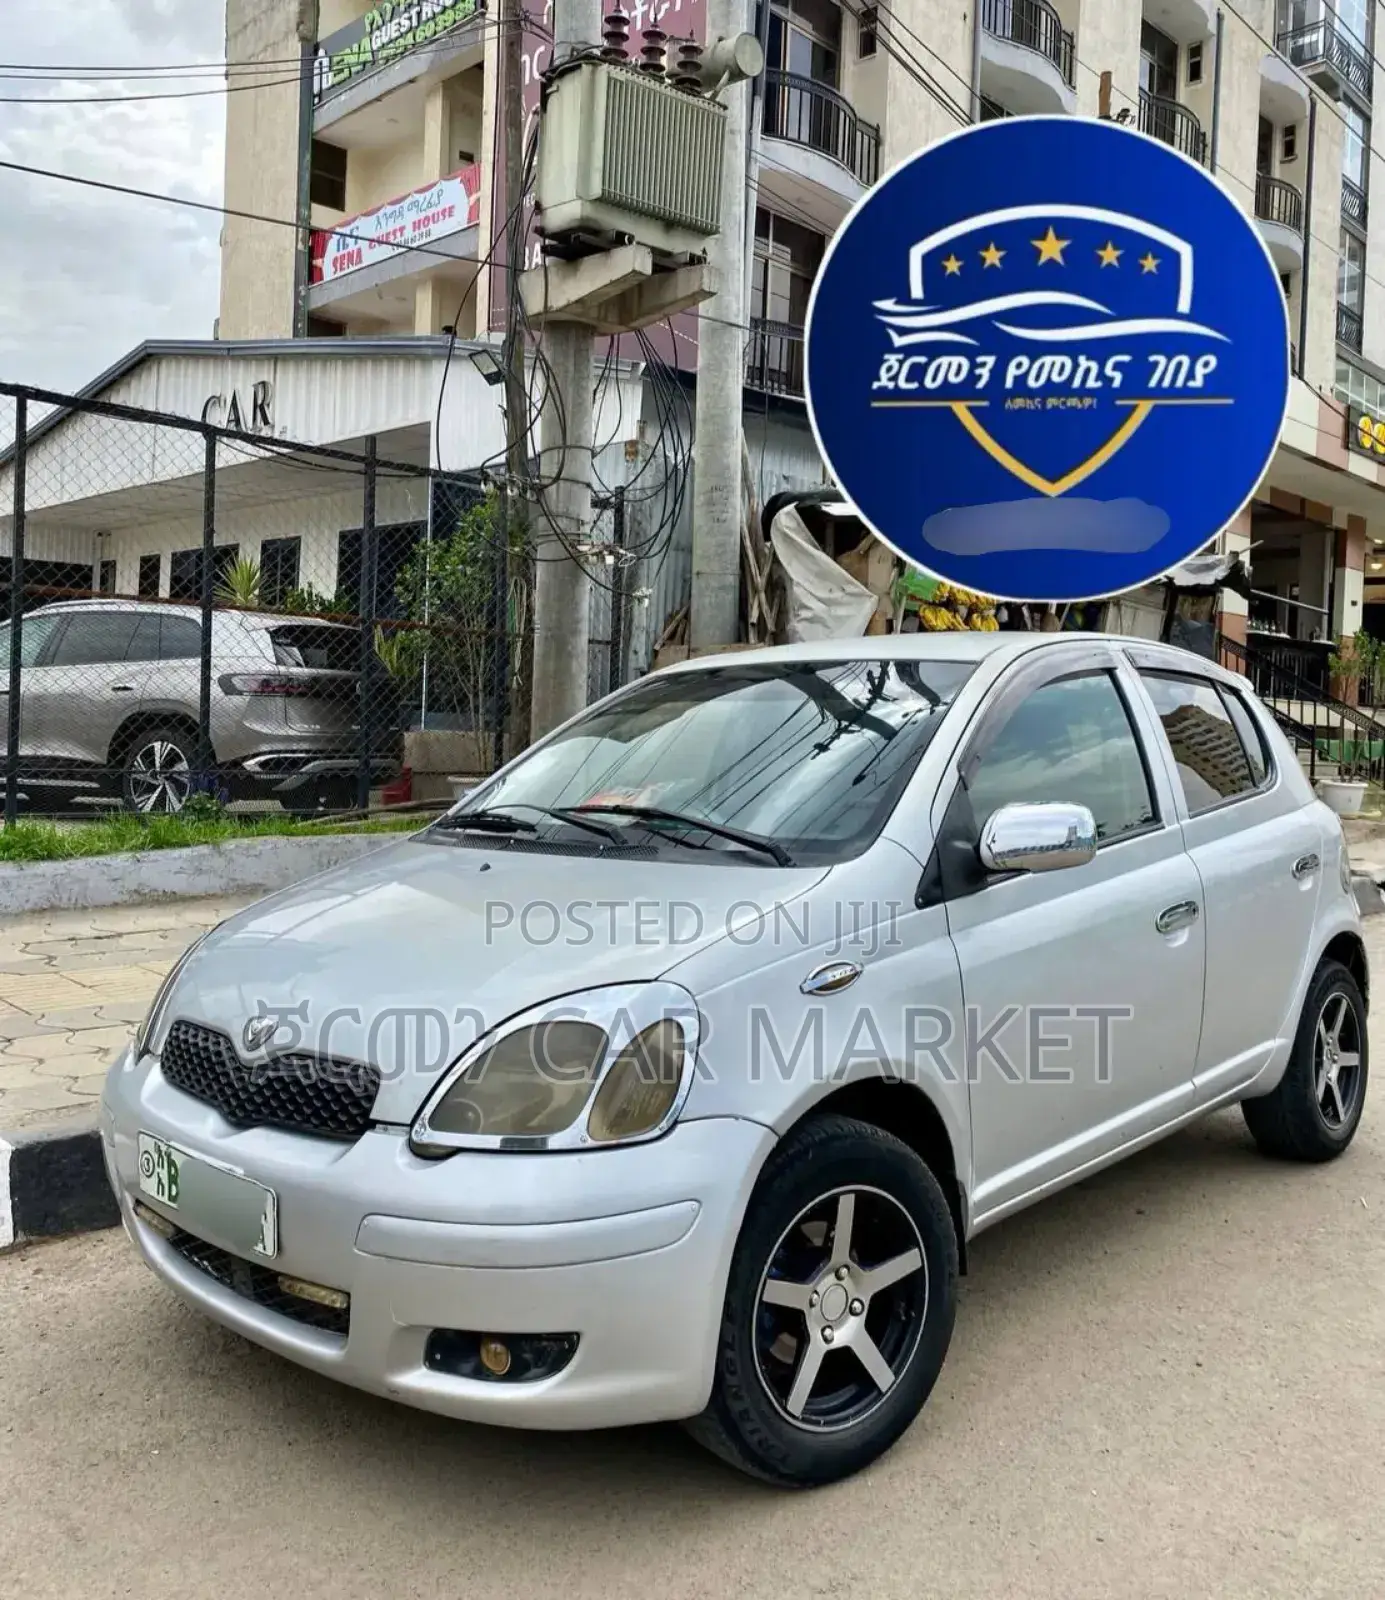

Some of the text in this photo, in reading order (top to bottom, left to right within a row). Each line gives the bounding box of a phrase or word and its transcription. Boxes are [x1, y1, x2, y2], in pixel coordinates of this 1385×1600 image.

[371, 6, 421, 51] GUEST
[332, 248, 364, 275] SENA
[368, 225, 406, 250] GUEST
[412, 205, 456, 231] HOUSE
[201, 380, 272, 432] CAR
